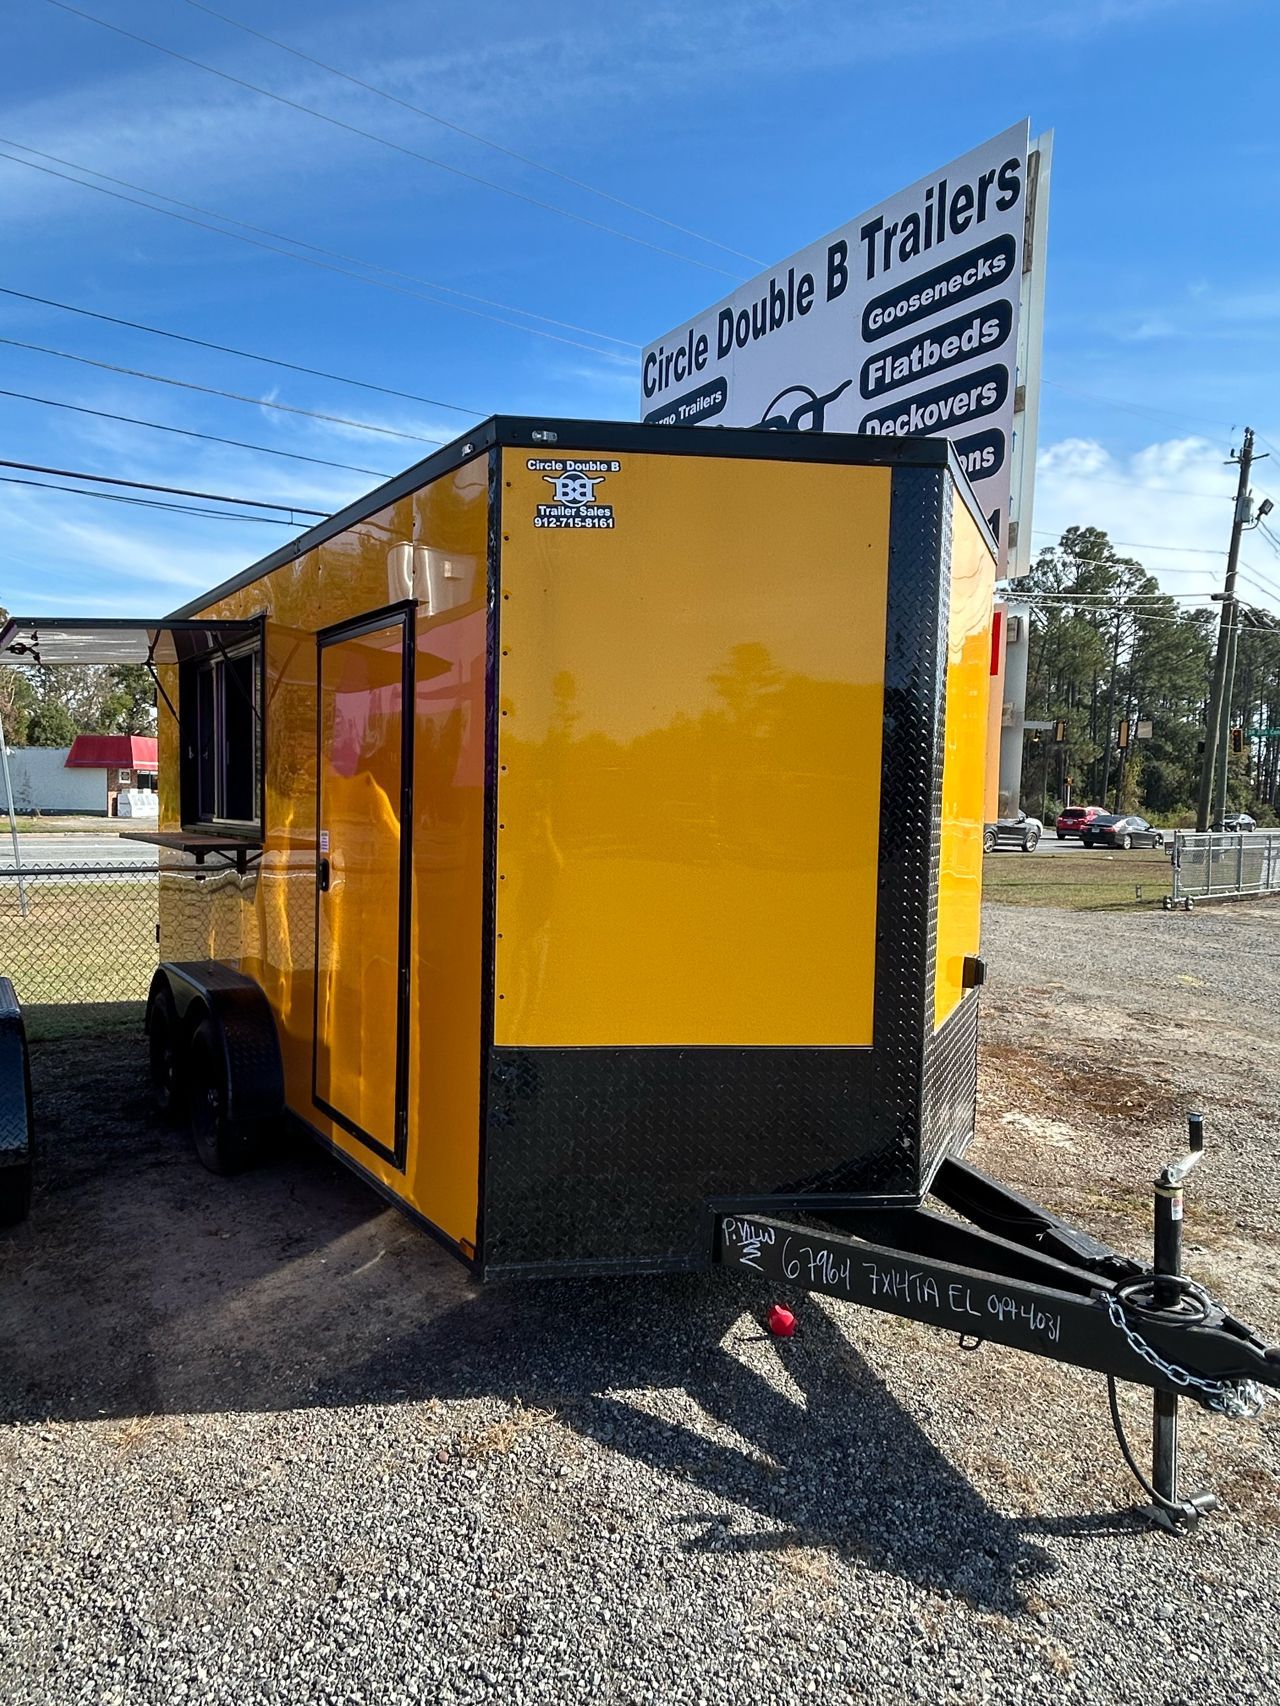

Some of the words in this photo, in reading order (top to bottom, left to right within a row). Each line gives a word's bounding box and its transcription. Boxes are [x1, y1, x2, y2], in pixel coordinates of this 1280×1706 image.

[643, 329, 708, 398] Circle
[717, 267, 815, 360] Double
[827, 239, 848, 302] B
[860, 157, 1021, 281] Trailers
[868, 251, 1006, 330] Goosenecks
[867, 315, 1000, 391] Flatbeds
[679, 391, 722, 420] Trailers
[527, 460, 563, 470] Circle
[566, 461, 608, 471] Double
[611, 462, 620, 471] B
[534, 518, 614, 528] 912-715-8161
[538, 506, 577, 516] Trailer
[579, 506, 611, 516] Sales
[782, 1237, 850, 1290] 67964
[949, 1284, 982, 1316] EL
